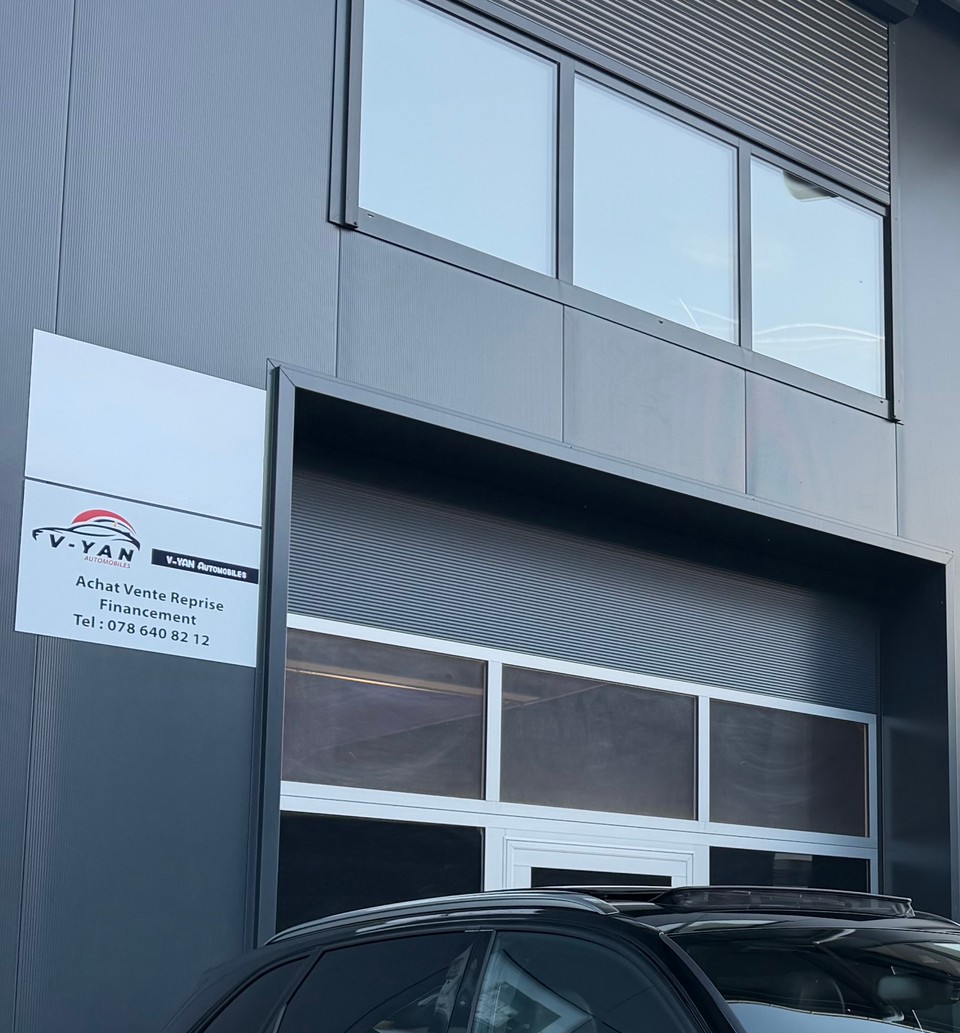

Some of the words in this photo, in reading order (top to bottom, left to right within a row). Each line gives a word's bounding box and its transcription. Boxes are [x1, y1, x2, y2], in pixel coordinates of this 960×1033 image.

[49, 534, 134, 562] V-YAN
[84, 555, 131, 569] AUTOMOBILES
[166, 555, 195, 569] V-YAN
[76, 575, 121, 593] Achat
[124, 583, 167, 602] Vente
[171, 592, 224, 612] Reprise
[100, 599, 197, 626] Financement
[107, 619, 136, 635] 078
[139, 625, 167, 639] 640
[171, 630, 189, 643] 82
[194, 633, 210, 647] 12
